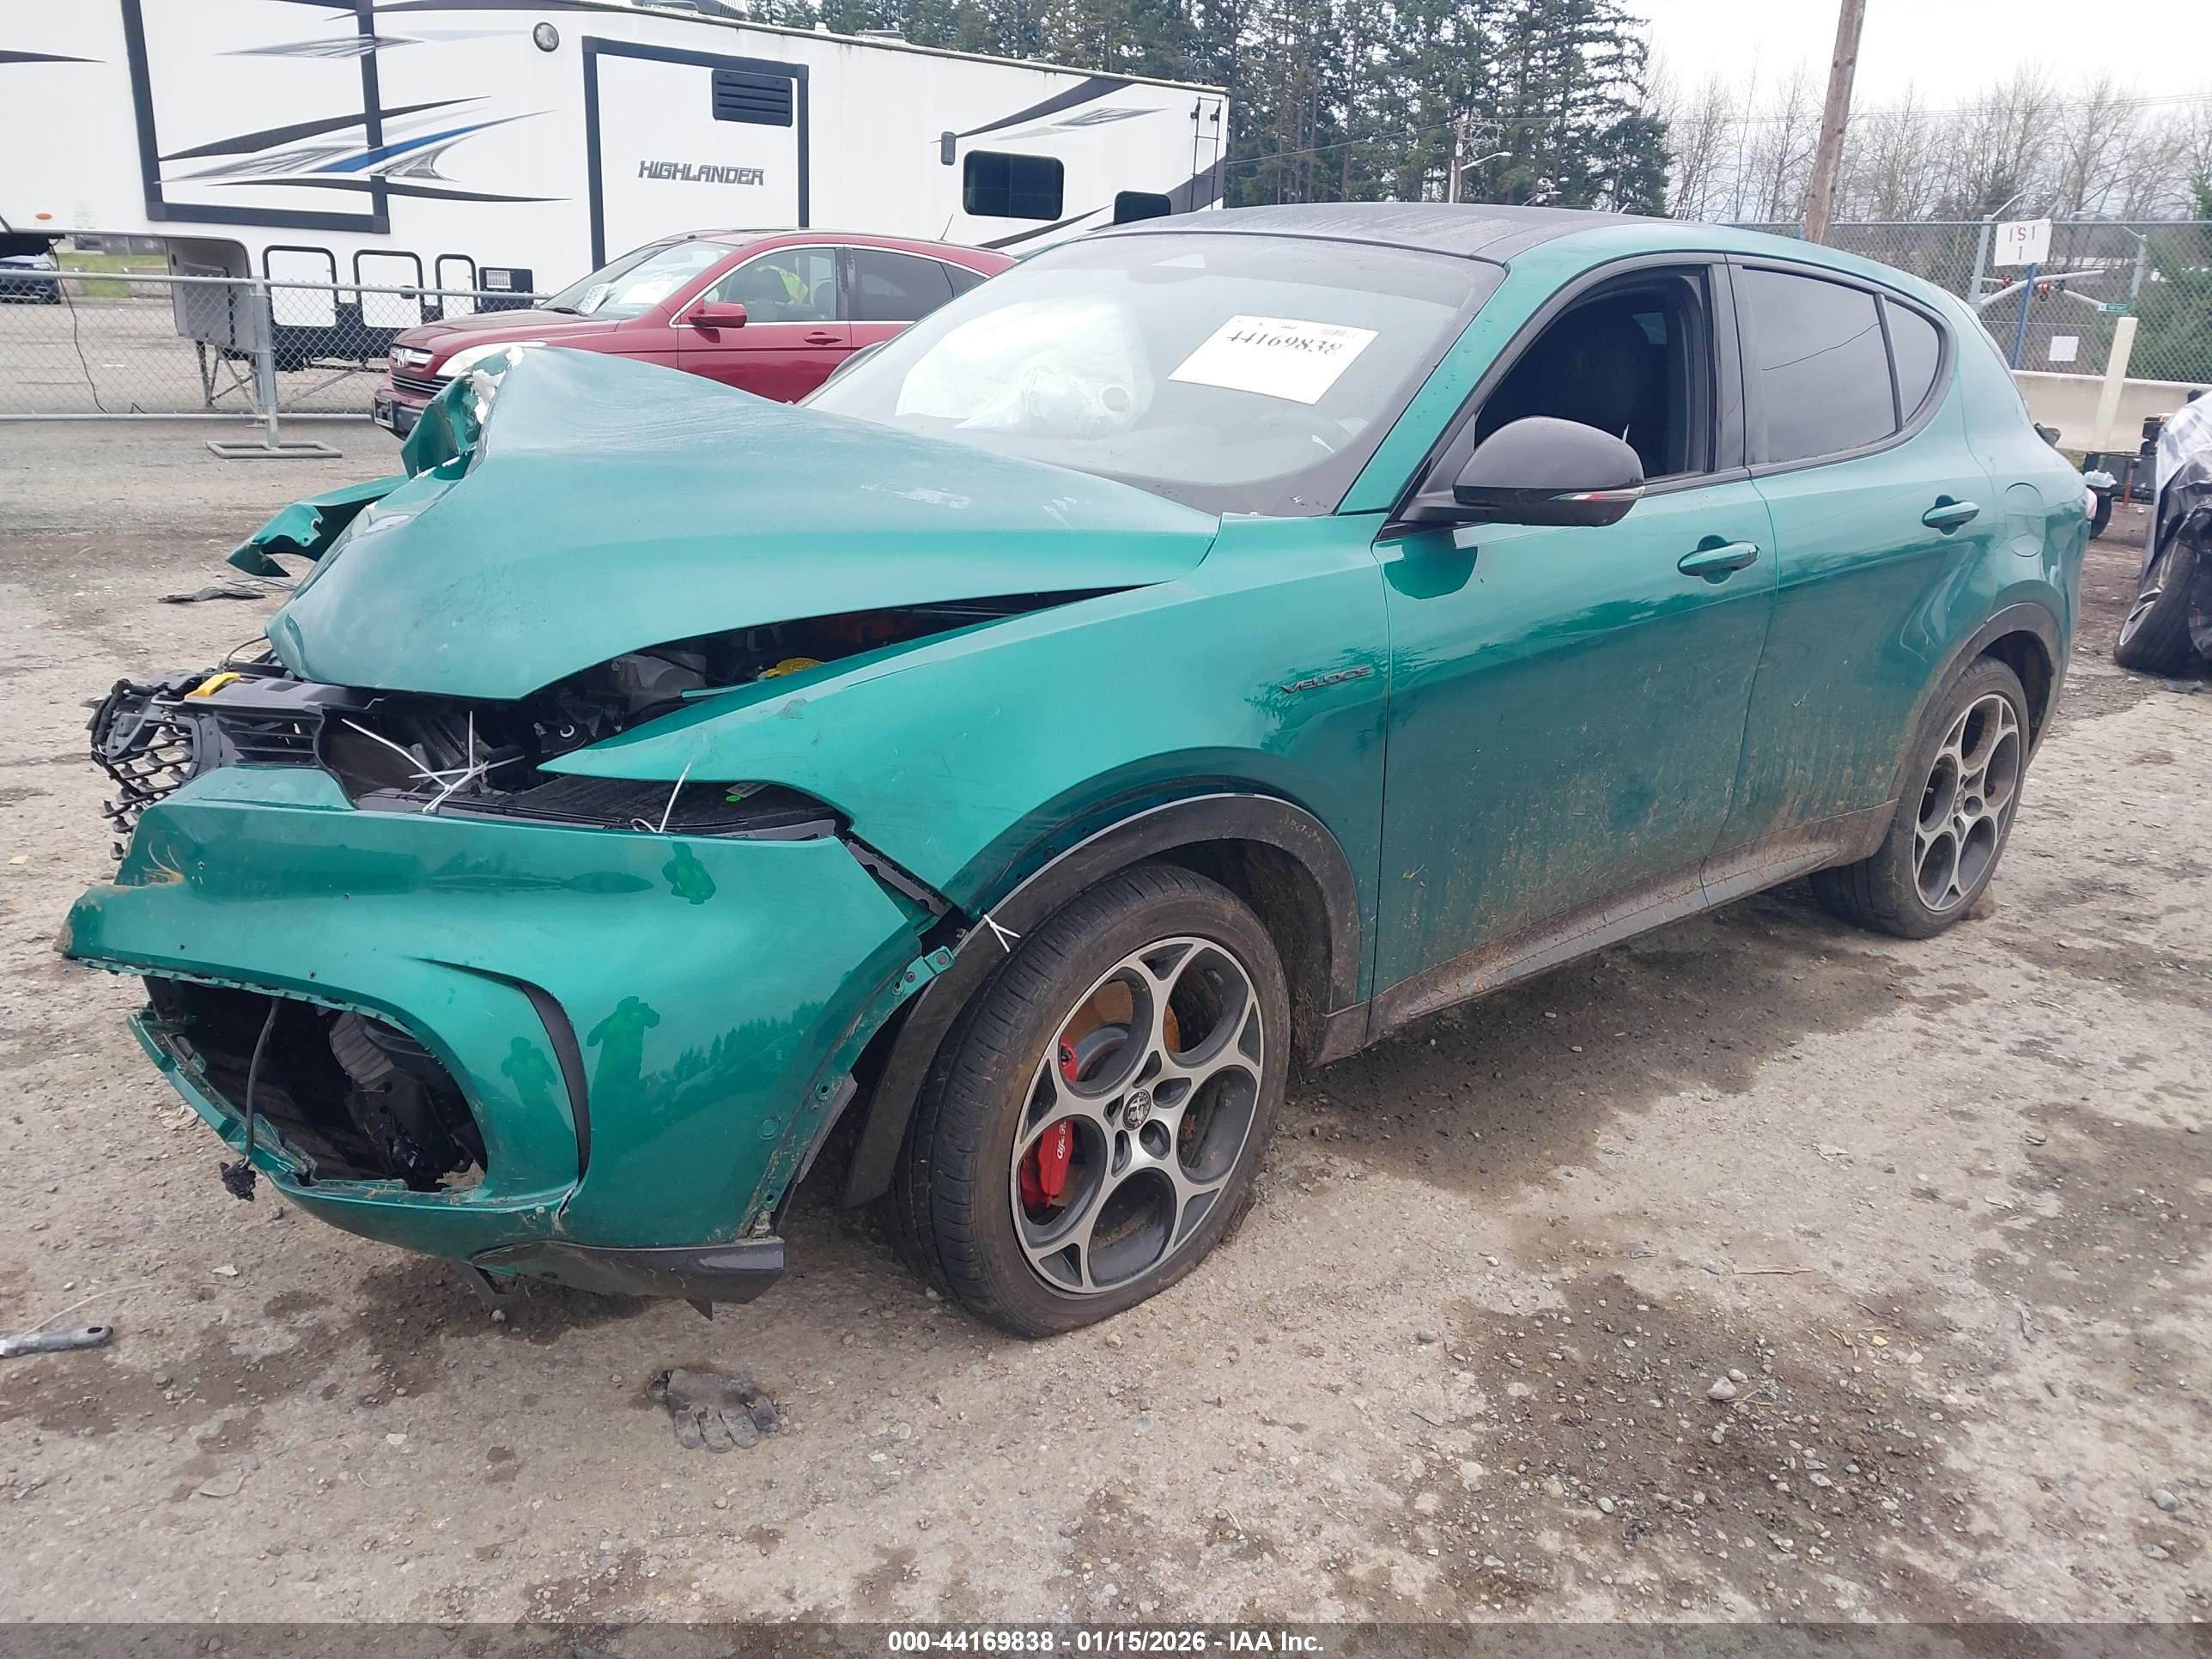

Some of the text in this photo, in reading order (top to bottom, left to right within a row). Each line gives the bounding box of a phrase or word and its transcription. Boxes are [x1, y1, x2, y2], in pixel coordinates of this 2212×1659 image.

[638, 160, 764, 186] HIGHLANDER
[1226, 330, 1342, 356] 44169838
[1280, 665, 1371, 694] VELOCE
